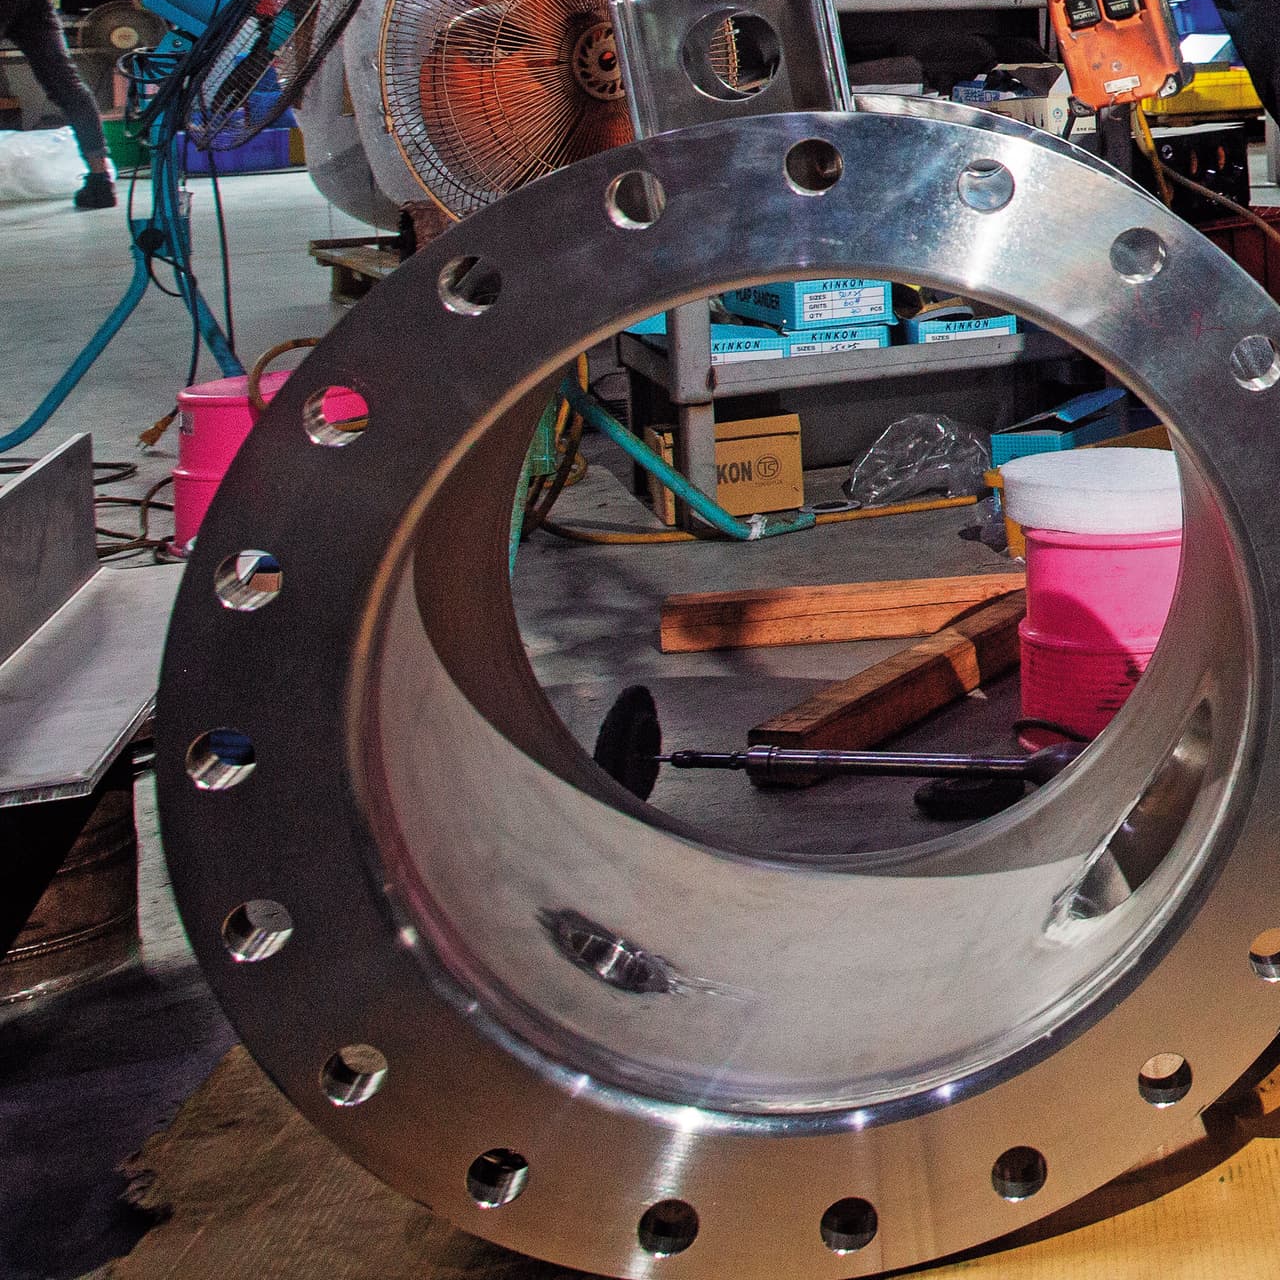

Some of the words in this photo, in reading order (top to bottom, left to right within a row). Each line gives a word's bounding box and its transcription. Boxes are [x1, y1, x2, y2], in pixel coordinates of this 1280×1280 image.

[1110, 2, 1129, 11] WEST
[1073, 10, 1096, 20] NORTH
[823, 280, 864, 290] KINKON
[945, 320, 989, 331] KINKON
[812, 331, 857, 340] KINKON
[713, 341, 760, 351] KINKON
[717, 460, 752, 484] KON
